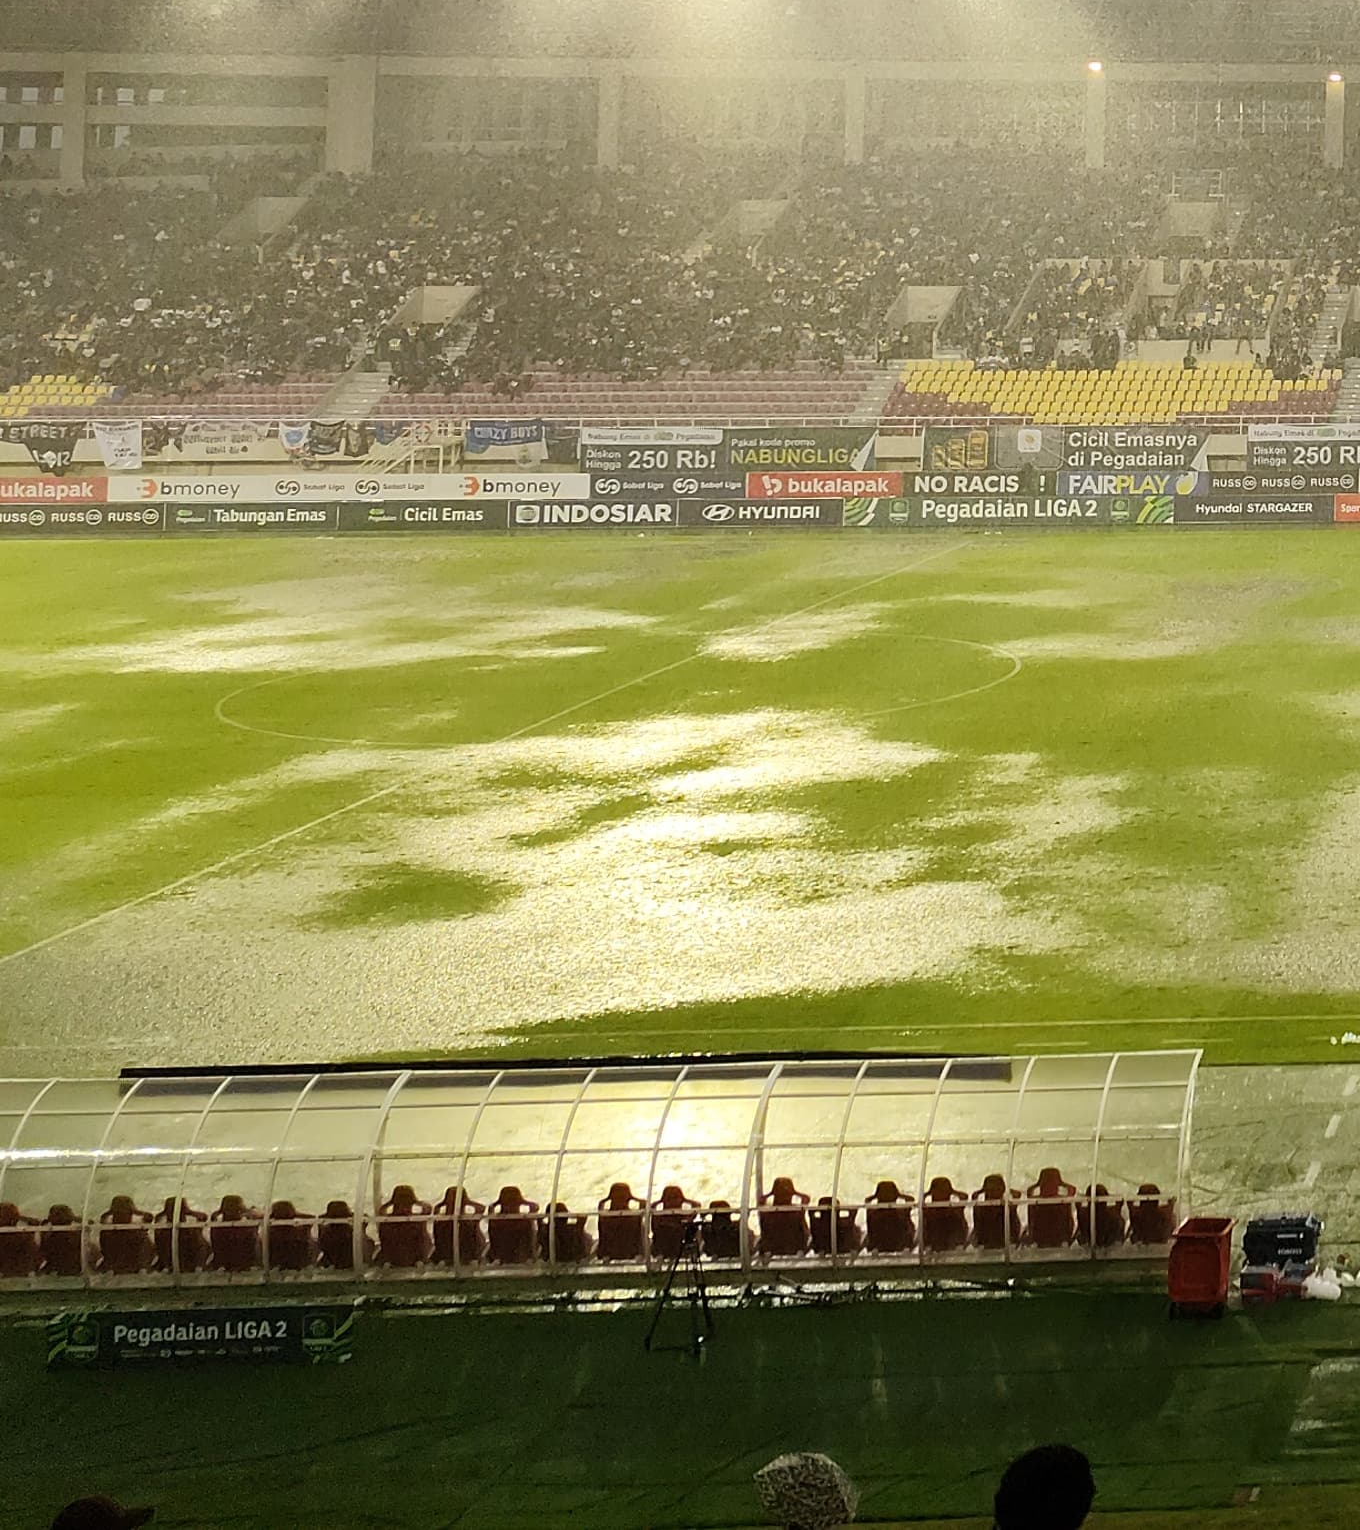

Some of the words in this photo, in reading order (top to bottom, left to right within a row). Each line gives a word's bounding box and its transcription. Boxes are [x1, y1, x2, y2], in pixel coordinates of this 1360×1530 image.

[9, 422, 68, 439] STREET
[510, 425, 538, 438] BOYS
[731, 438, 757, 446] Pakai
[760, 438, 782, 446] kode
[784, 439, 816, 447] promo
[1068, 432, 1108, 447] Cicil
[1115, 432, 1197, 450] Emasnya
[586, 449, 621, 458] Diskon
[1253, 446, 1287, 455] Diskon
[1293, 446, 1332, 465] 250
[586, 461, 621, 470] Hingga
[628, 450, 668, 469] 250
[676, 450, 716, 469] Rb!
[1068, 452, 1084, 466] di
[1091, 452, 1184, 469] Pegadaian
[1253, 457, 1287, 467] Hingga
[0, 482, 94, 500] ukalapak
[161, 482, 240, 498] bmoney
[483, 479, 561, 497] bmoney
[788, 478, 889, 496] bukalapak
[914, 475, 948, 493] NO
[954, 475, 1019, 493] RACIS
[1039, 475, 1045, 492] !
[1069, 475, 1170, 494] FAIRPLAY
[214, 509, 285, 525] Tabungan
[287, 509, 326, 521] Emas
[404, 507, 437, 521] Cicil
[442, 508, 484, 521] Emas
[543, 504, 672, 523] INDOSIAR
[739, 506, 820, 519] HYUNDAI
[922, 500, 1028, 522] Pegadaian
[1035, 500, 1081, 517] LIGA
[1085, 500, 1097, 517] 2
[1196, 504, 1242, 515] Hyundai
[1247, 503, 1313, 513] STARGAZER
[114, 1324, 219, 1347] Pegadaian
[225, 1321, 271, 1340] LIGA
[275, 1321, 287, 1338] 2
